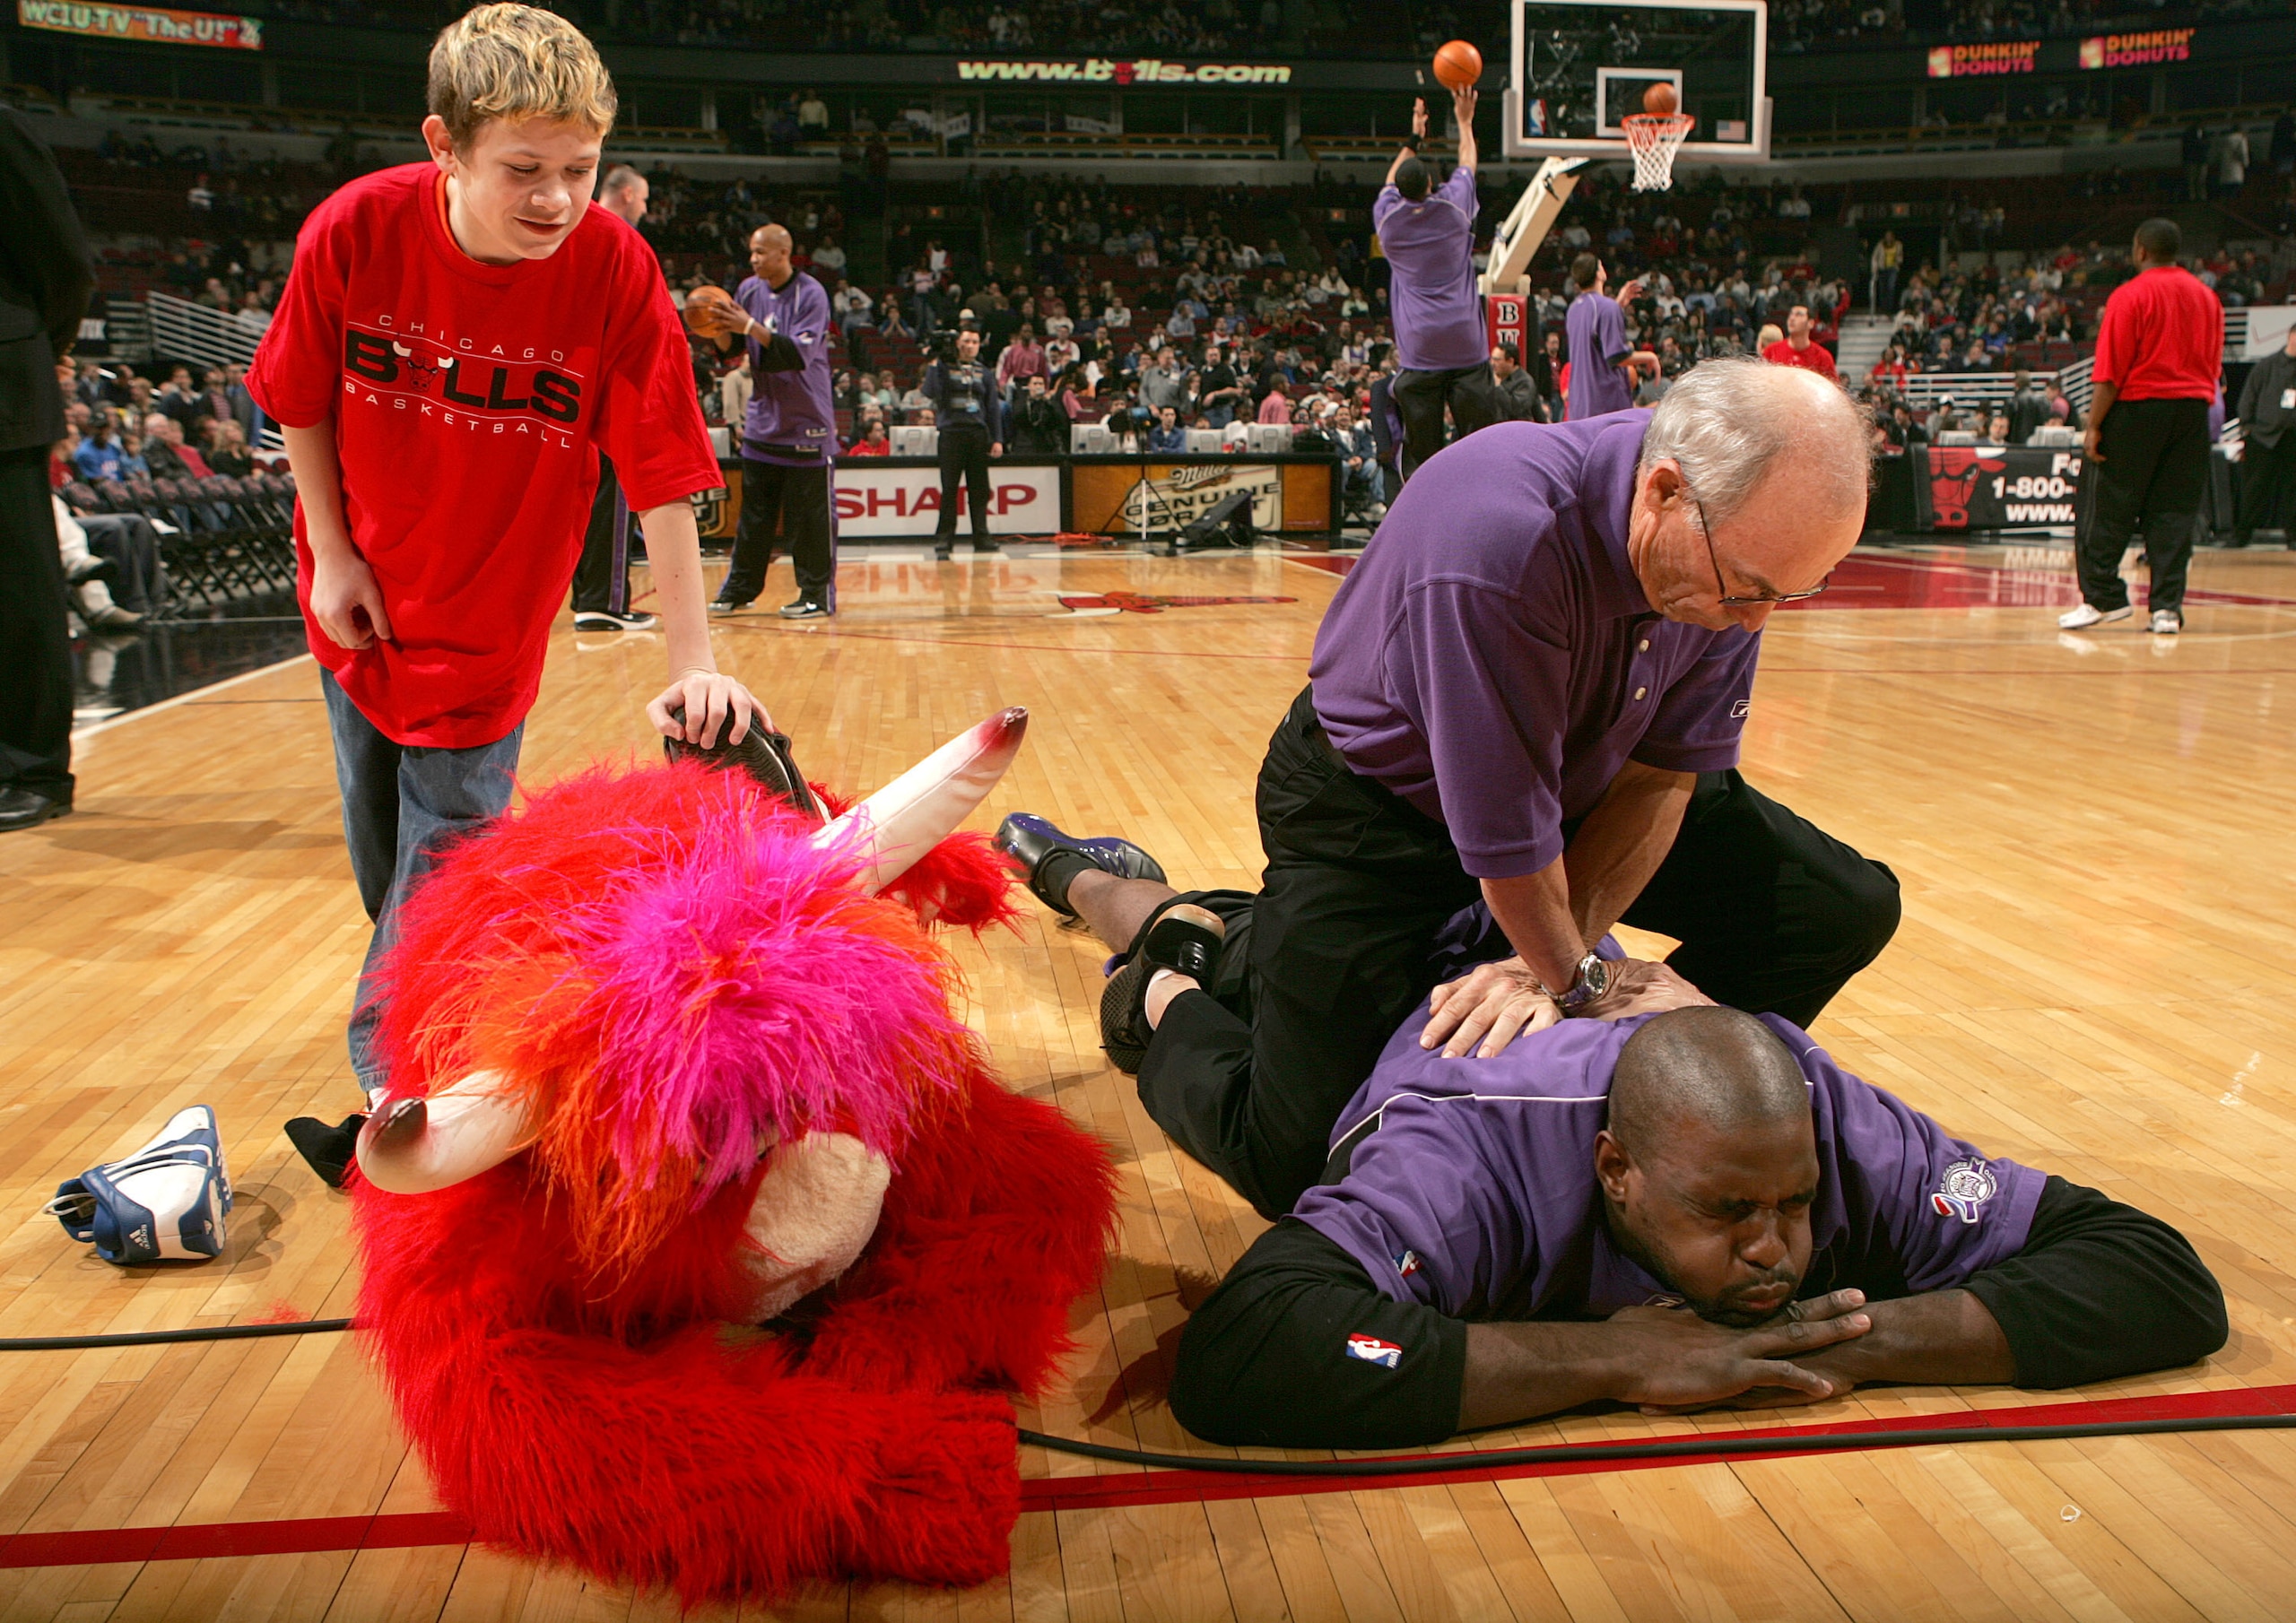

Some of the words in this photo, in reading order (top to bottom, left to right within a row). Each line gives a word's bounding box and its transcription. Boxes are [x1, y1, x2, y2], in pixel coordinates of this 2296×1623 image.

[1953, 56, 2034, 76] DONUTS
[2105, 46, 2190, 66] DONUTS
[378, 315, 564, 362] CHICAGO
[344, 382, 570, 448] BASKETBALL
[1170, 464, 1231, 484] Miller
[1992, 476, 2078, 499] 1-800-
[1146, 499, 1266, 527] DRT
